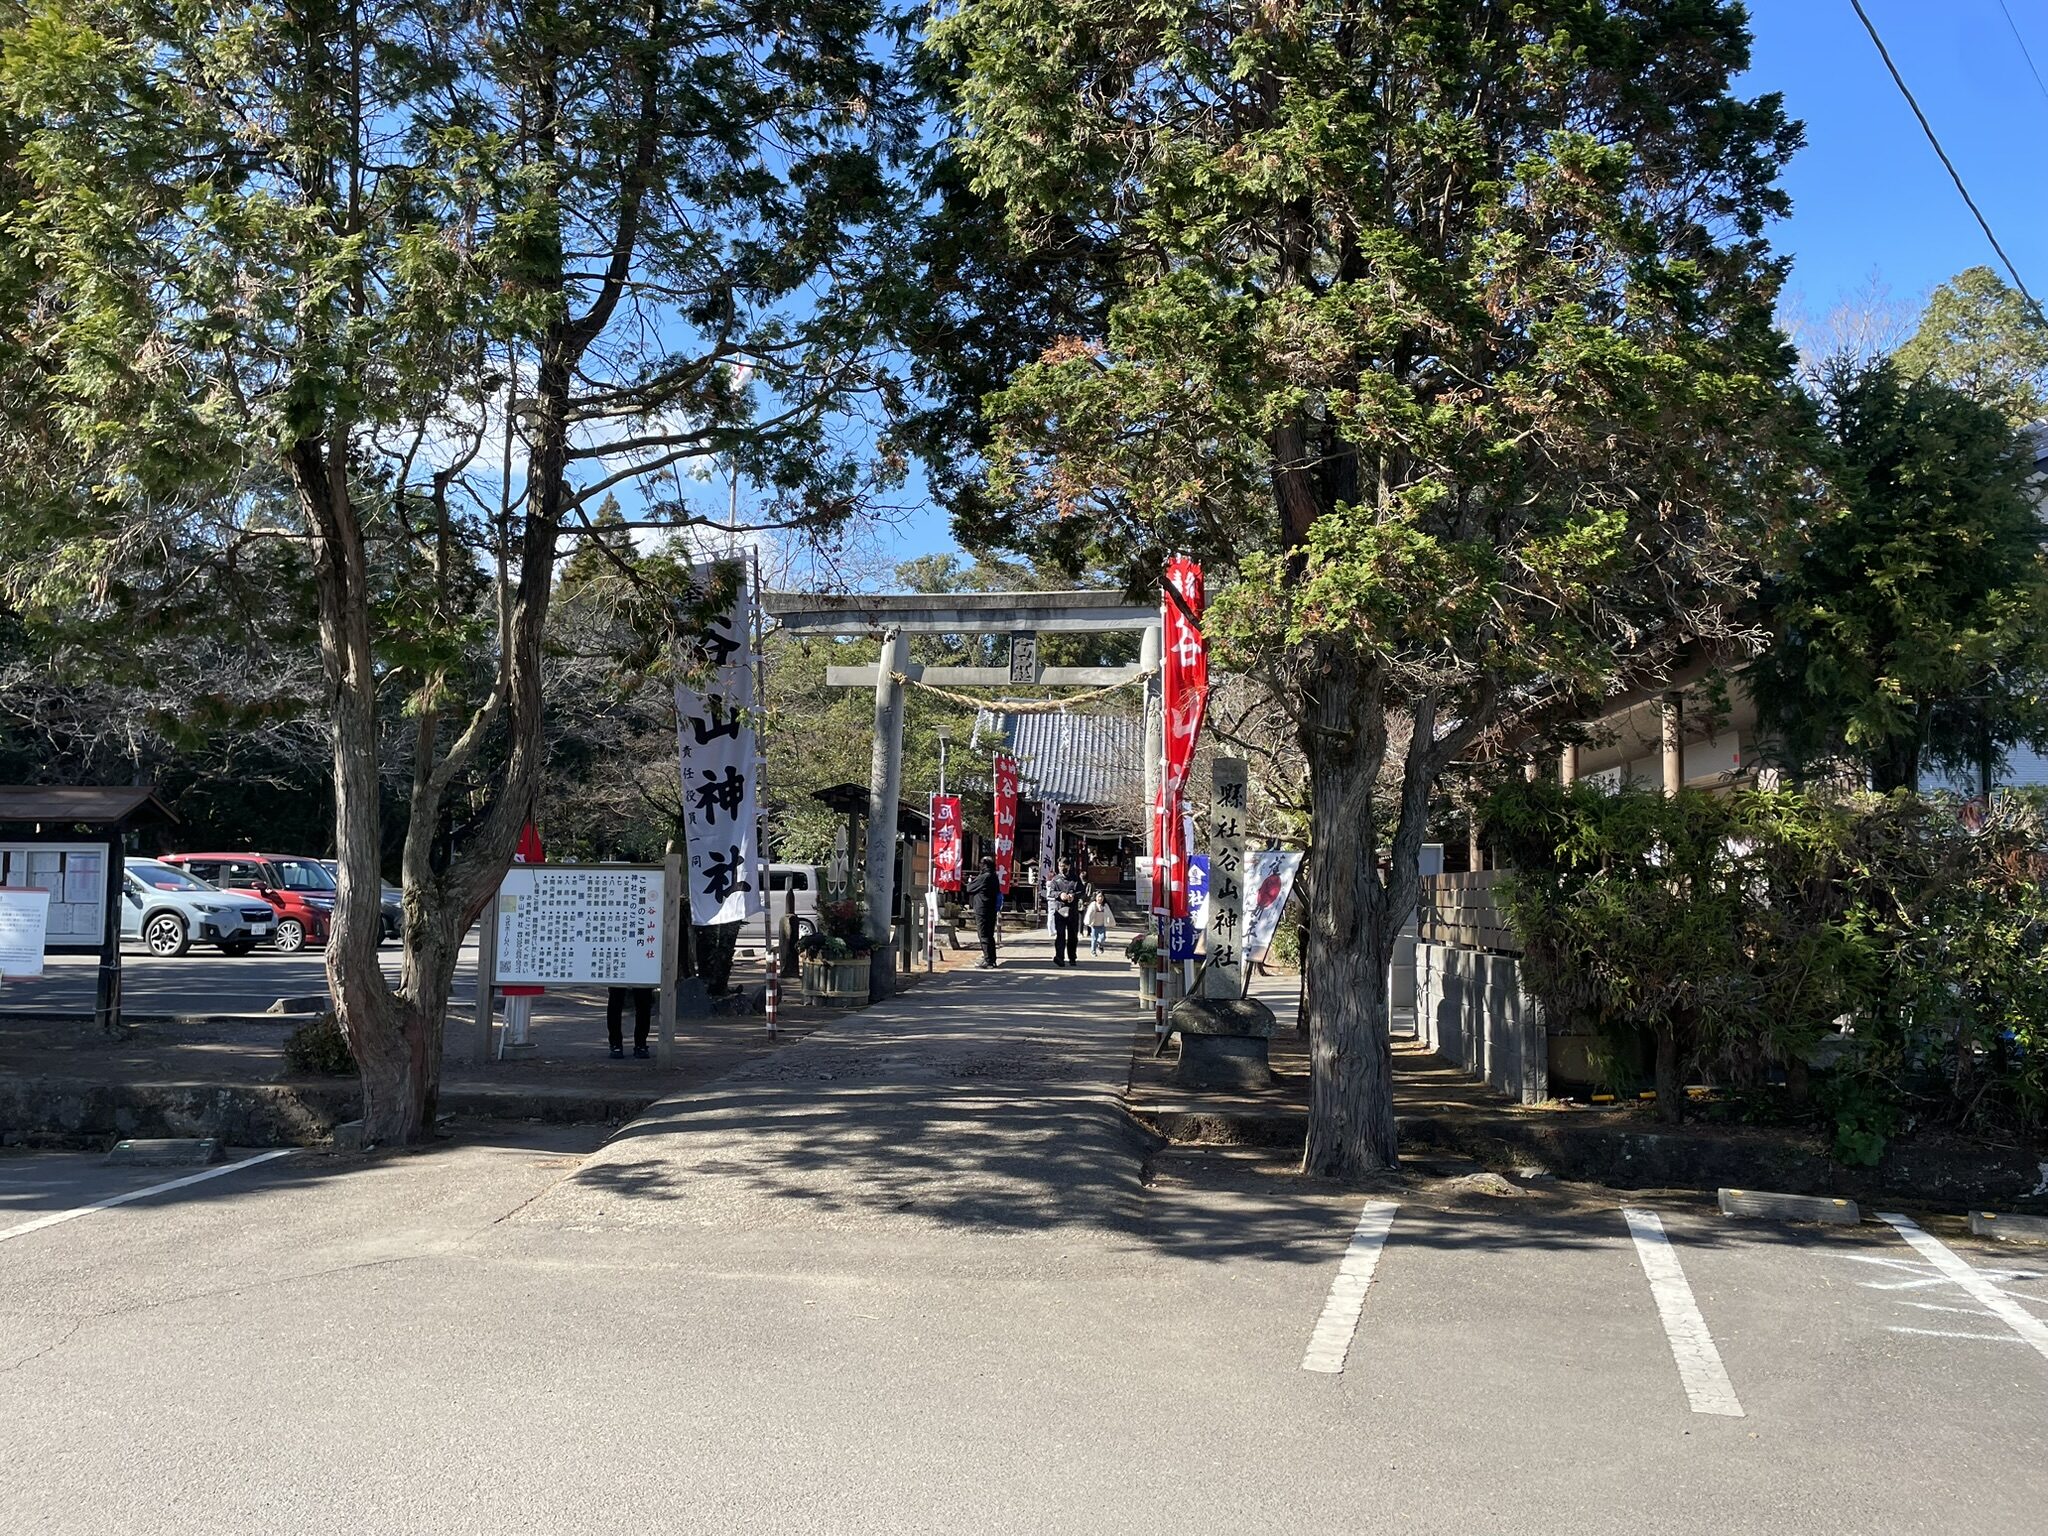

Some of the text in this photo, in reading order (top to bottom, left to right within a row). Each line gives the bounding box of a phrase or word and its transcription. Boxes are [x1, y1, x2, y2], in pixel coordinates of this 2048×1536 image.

[682, 744, 702, 869] 責任役員一同
[694, 615, 751, 904] 谷山神社
[628, 874, 638, 938] 神社でのご祈願
[637, 876, 646, 947] ご祈願のご案内
[1208, 783, 1243, 968] 縣社谷山神社
[646, 907, 656, 959] 谷山神社
